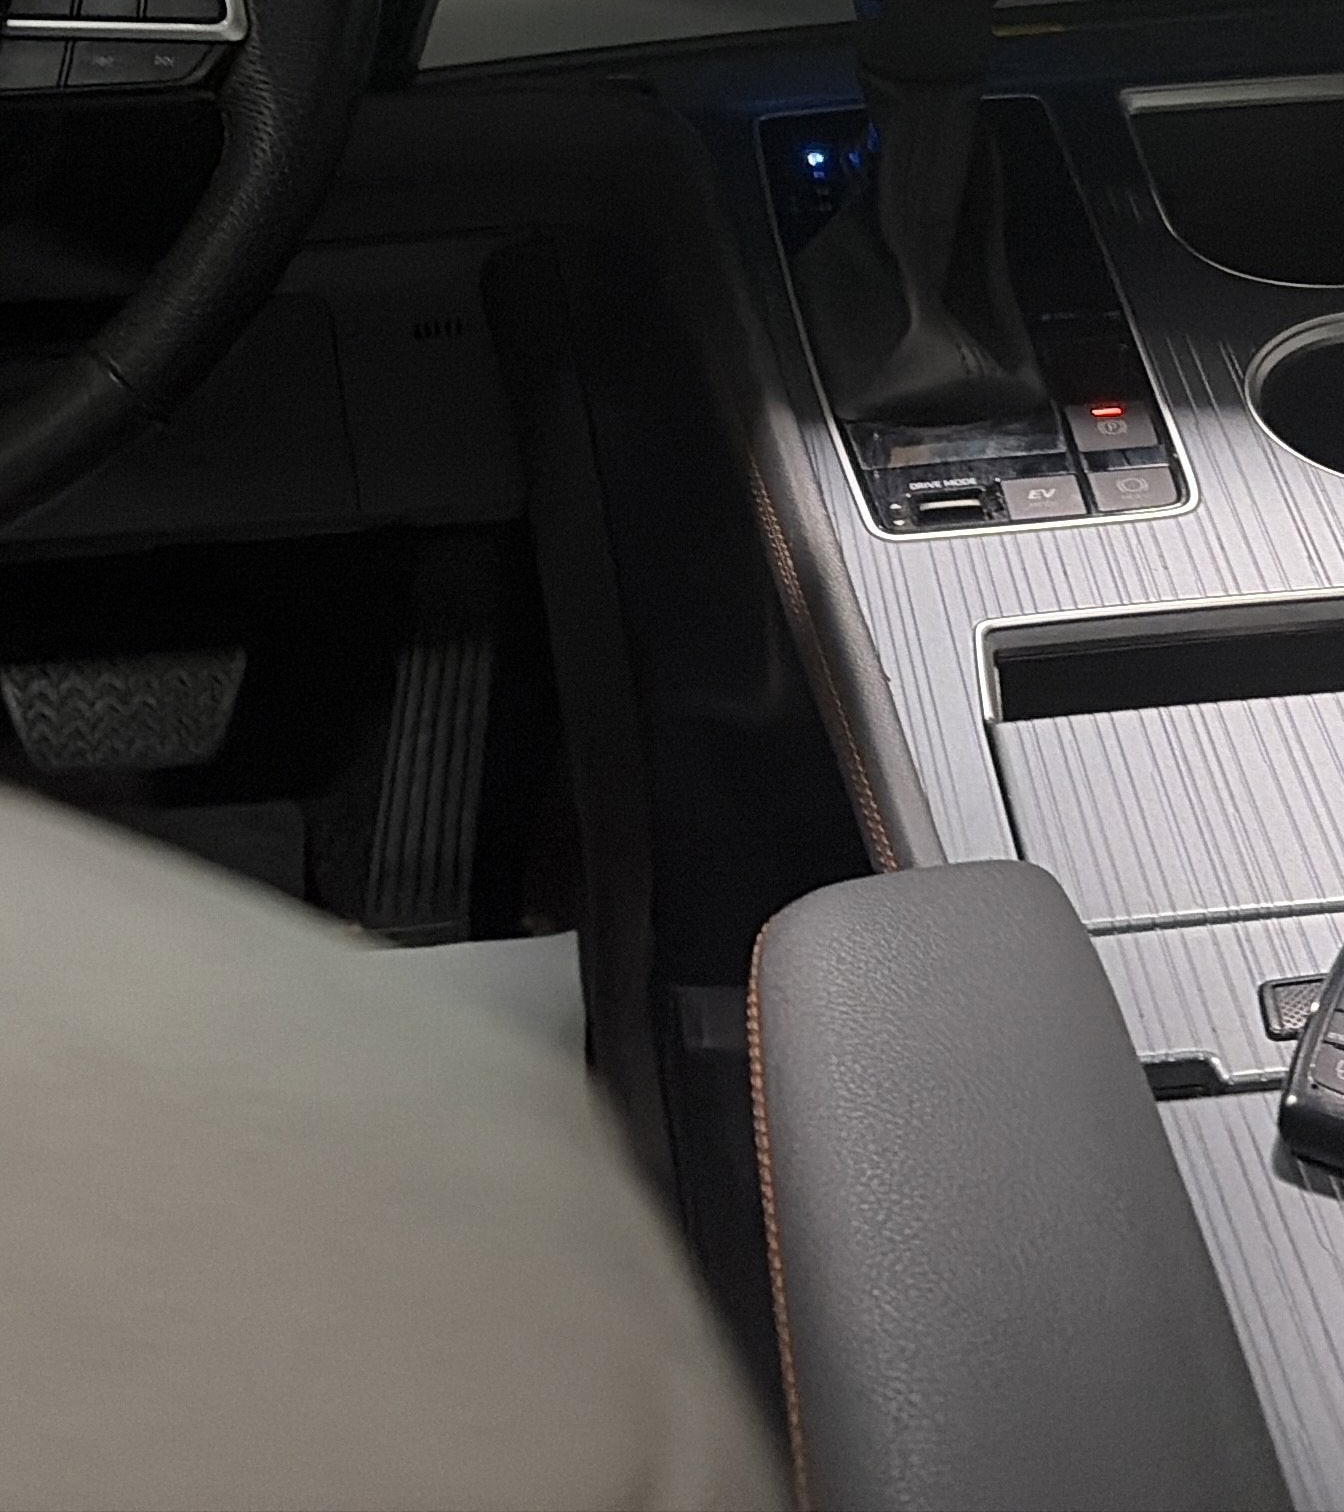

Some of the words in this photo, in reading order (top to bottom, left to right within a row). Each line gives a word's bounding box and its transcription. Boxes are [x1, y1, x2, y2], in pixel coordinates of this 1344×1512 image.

[909, 480, 941, 491] DRIVE
[943, 477, 977, 488] MODE
[1027, 488, 1056, 500] EV
